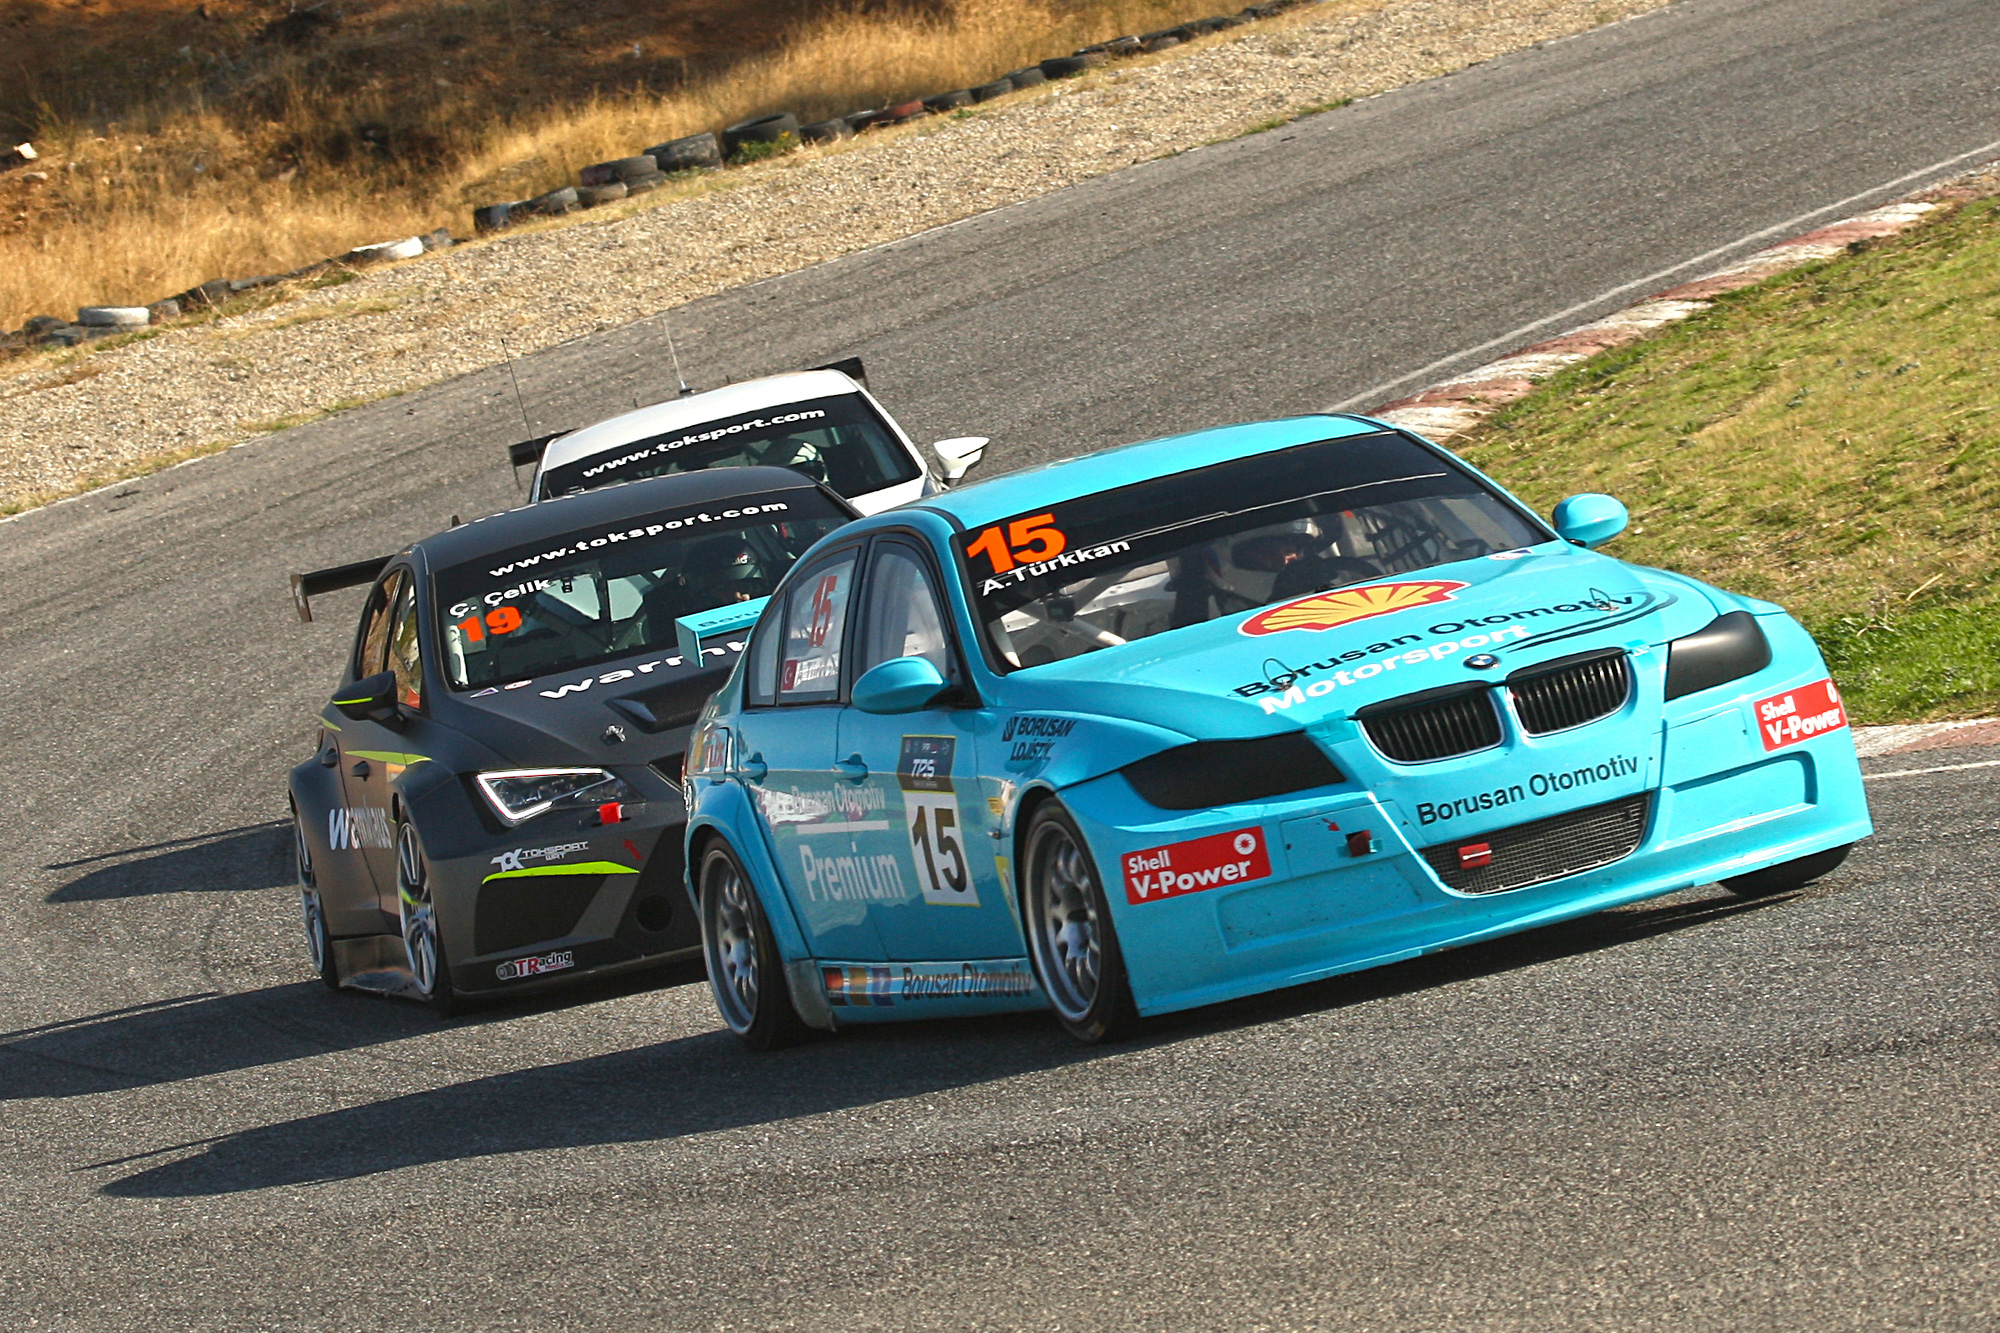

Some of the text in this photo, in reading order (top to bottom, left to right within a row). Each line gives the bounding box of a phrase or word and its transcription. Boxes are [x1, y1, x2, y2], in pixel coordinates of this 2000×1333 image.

[582, 408, 826, 478] www.toksport.com
[489, 501, 789, 577] www.toksport.com
[966, 513, 1067, 574] 15
[457, 606, 522, 643] 19
[1233, 634, 1423, 697] Borusan
[1258, 624, 1531, 715] Motorsport
[1017, 716, 1078, 738] BORUSAN
[1760, 695, 1797, 721] Shell
[1765, 708, 1840, 745] V-Power
[834, 781, 886, 813] Otomotiv
[1416, 754, 1639, 826] Borusan Otomotiv
[912, 805, 967, 893] 15
[1128, 849, 1171, 875] Shell
[799, 841, 906, 902] Premium
[1131, 860, 1251, 899] V-Power
[515, 951, 573, 977] TRacing
[902, 966, 960, 1001] Borusan
